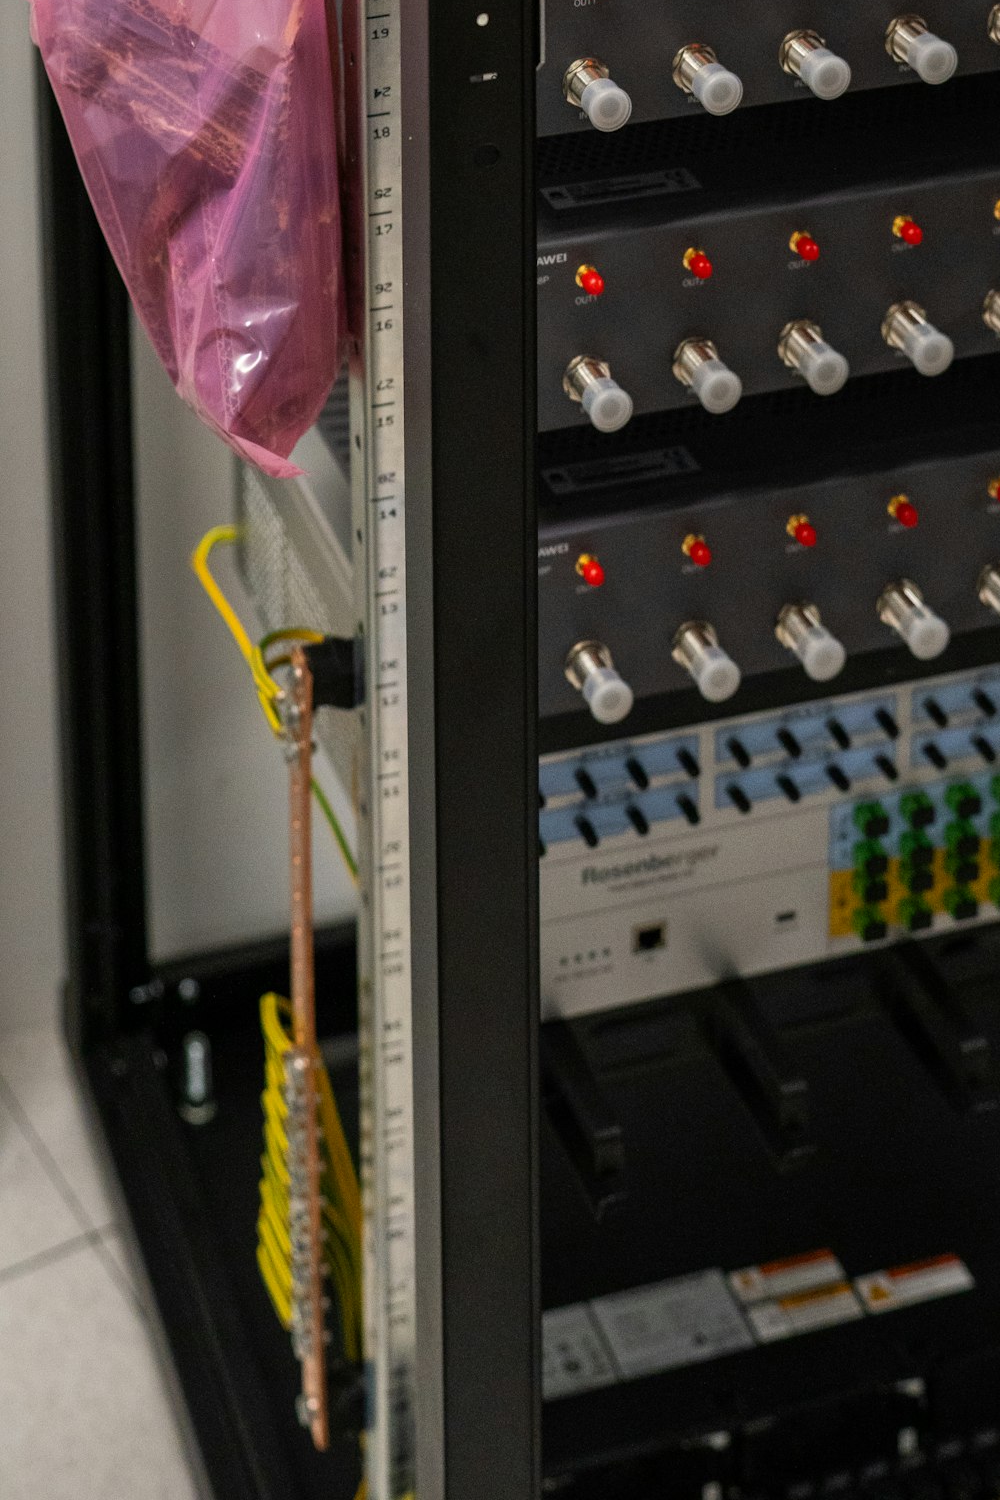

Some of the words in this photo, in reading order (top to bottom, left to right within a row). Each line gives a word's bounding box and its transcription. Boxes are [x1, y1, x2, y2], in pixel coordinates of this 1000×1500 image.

[372, 28, 390, 40] 19
[374, 86, 391, 98] 24
[373, 126, 390, 140] 18
[374, 188, 392, 198] 25
[375, 224, 392, 236] 17
[536, 253, 567, 266] AWEI
[376, 319, 392, 332] 16
